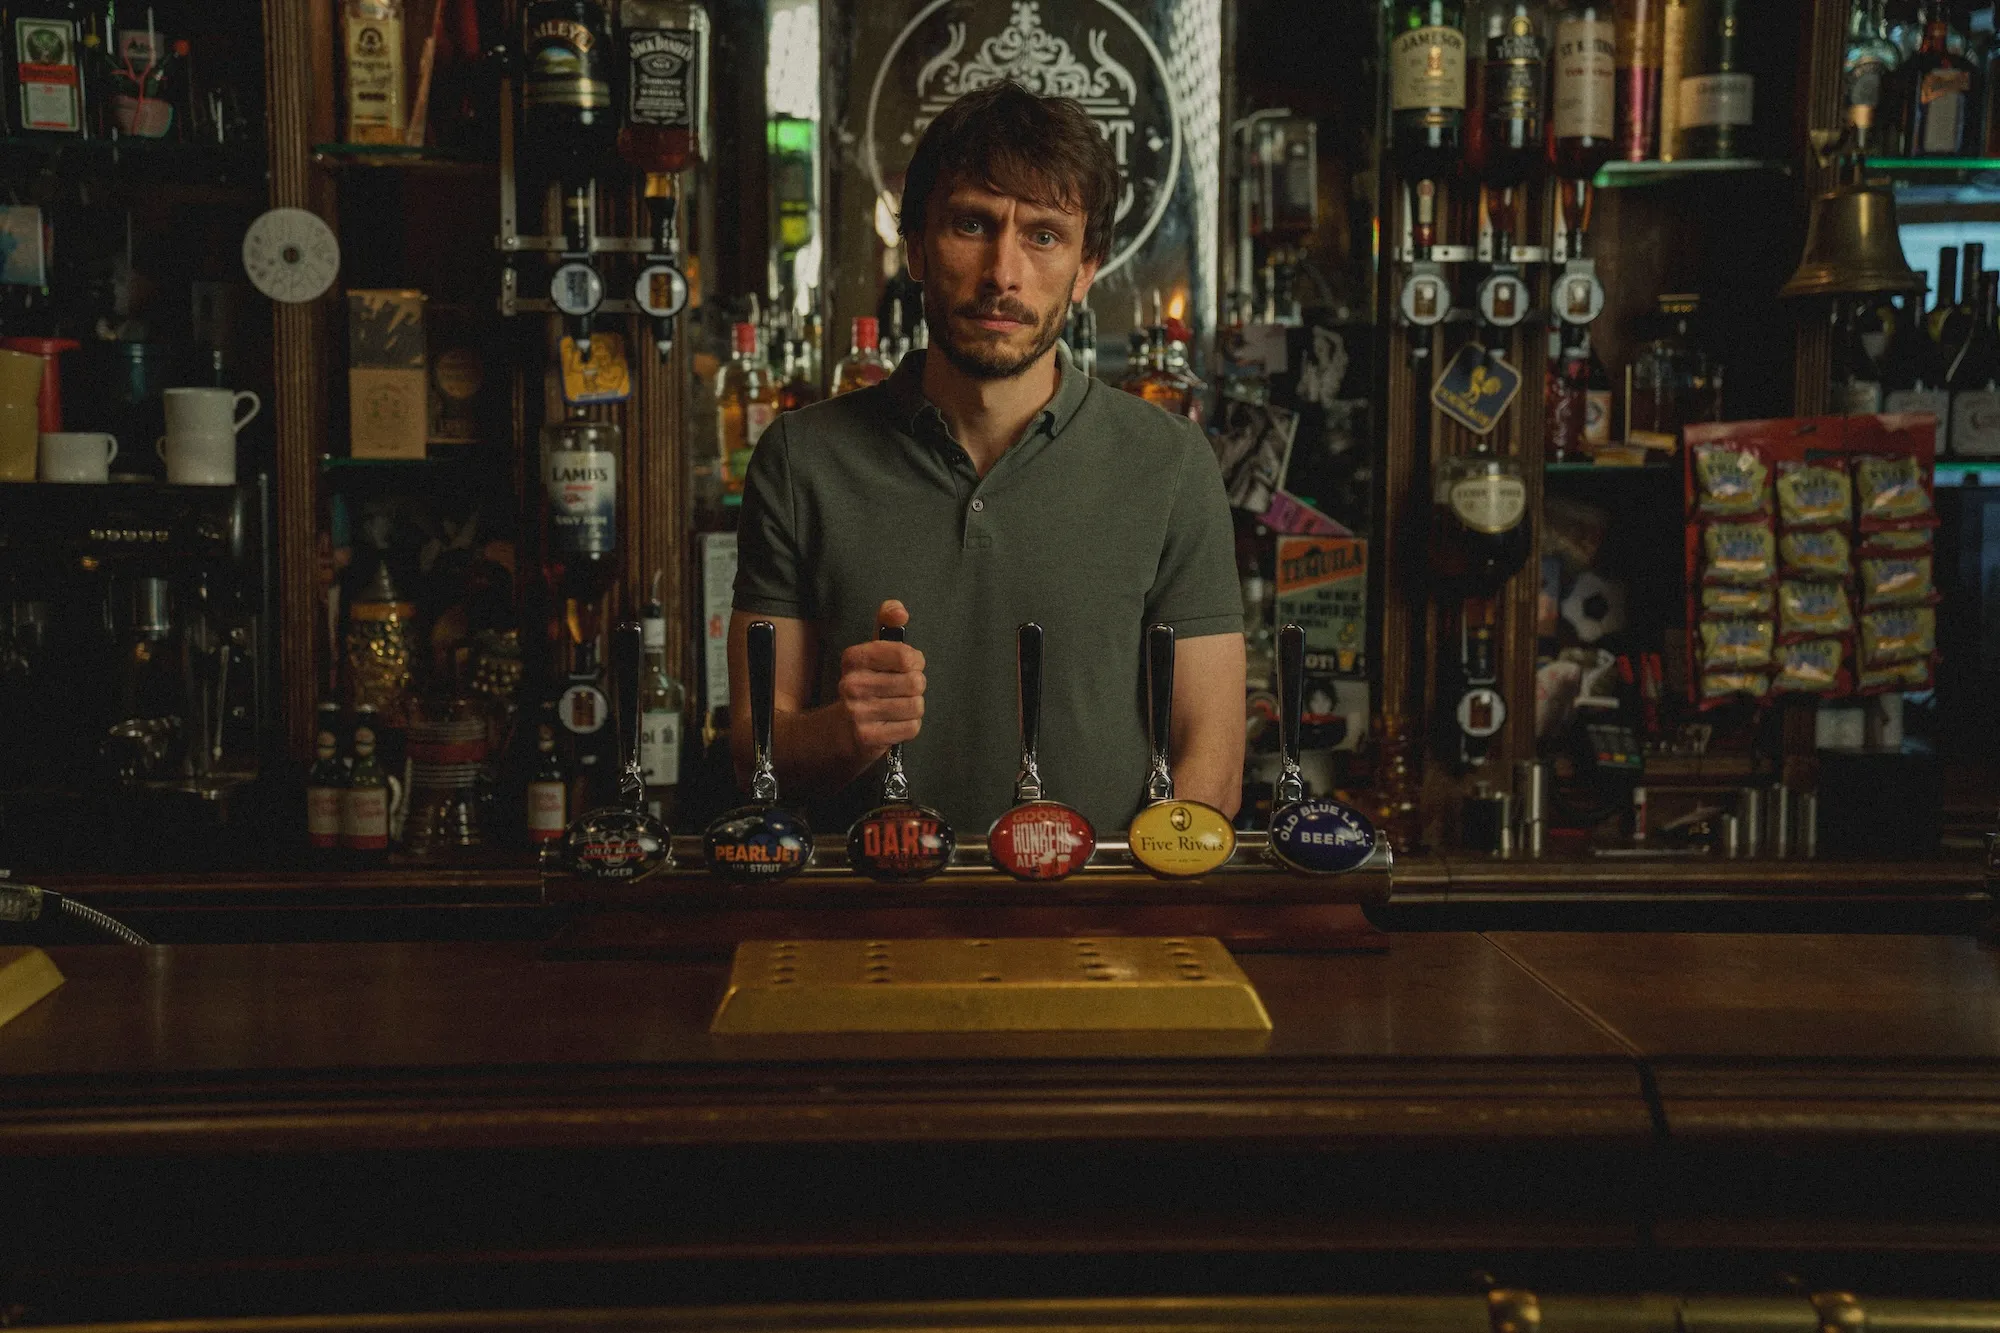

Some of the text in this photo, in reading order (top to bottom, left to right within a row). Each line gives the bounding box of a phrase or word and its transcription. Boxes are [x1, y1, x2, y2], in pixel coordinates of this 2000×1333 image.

[1011, 811, 1071, 824] GOOSE
[1280, 803, 1368, 848] OLD BLUE LAST
[863, 821, 941, 858] DARK
[1011, 820, 1073, 855] HONKERS
[1141, 836, 1225, 851] Five Rivers
[1301, 832, 1346, 847] BEER
[714, 843, 771, 863] PEARL
[749, 863, 782, 874] STOUT
[1016, 853, 1042, 869] ALE
[597, 867, 634, 878] LAGER
